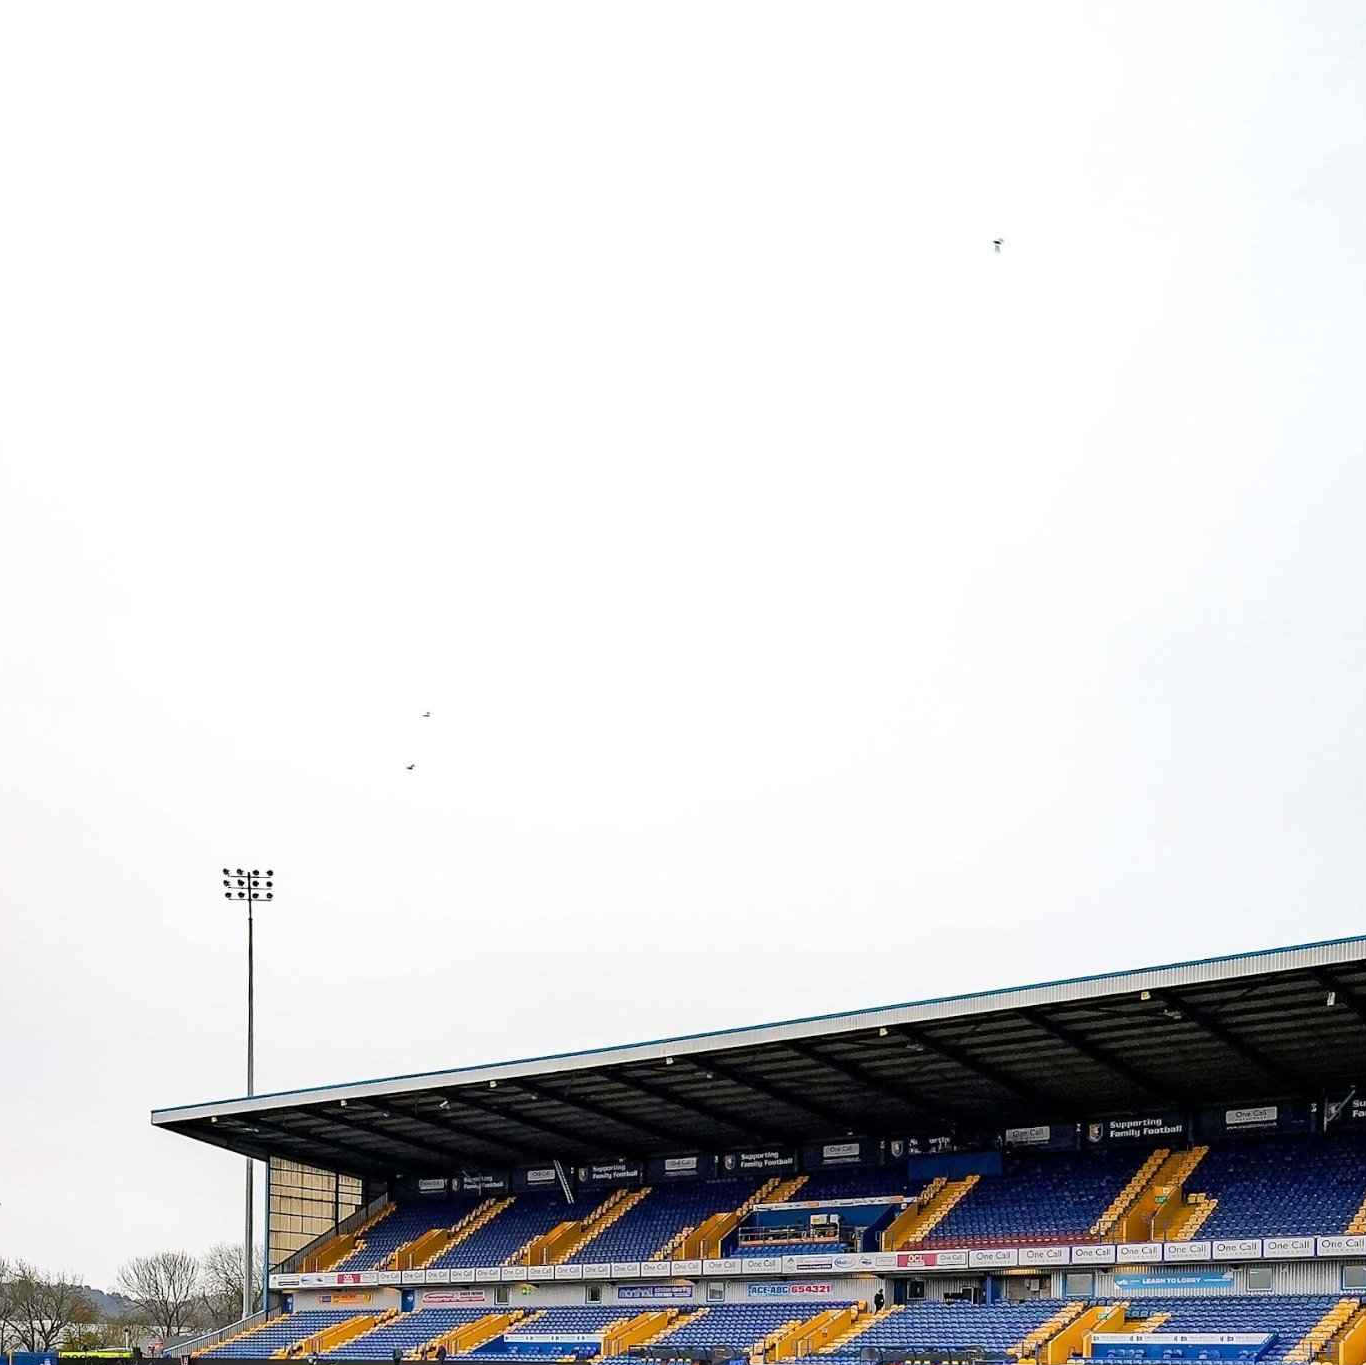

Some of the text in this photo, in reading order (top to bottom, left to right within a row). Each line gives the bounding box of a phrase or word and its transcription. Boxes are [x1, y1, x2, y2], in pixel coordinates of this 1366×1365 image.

[1110, 1118, 1163, 1129] Supporting
[1110, 1124, 1183, 1138] Family Football
[741, 1151, 779, 1161] Supporting
[741, 1157, 793, 1168] Family Football
[1239, 1243, 1256, 1251] Call
[1268, 1241, 1309, 1250] One Call
[1321, 1239, 1365, 1248] One Call
[1026, 1250, 1062, 1258] One Call
[1075, 1248, 1111, 1257] One Call
[1168, 1245, 1206, 1254] One Call
[976, 1251, 1011, 1260] One Call
[709, 1261, 735, 1270] One Call
[747, 1260, 762, 1268] One
[751, 1285, 831, 1294] ACE-ABC 654321
